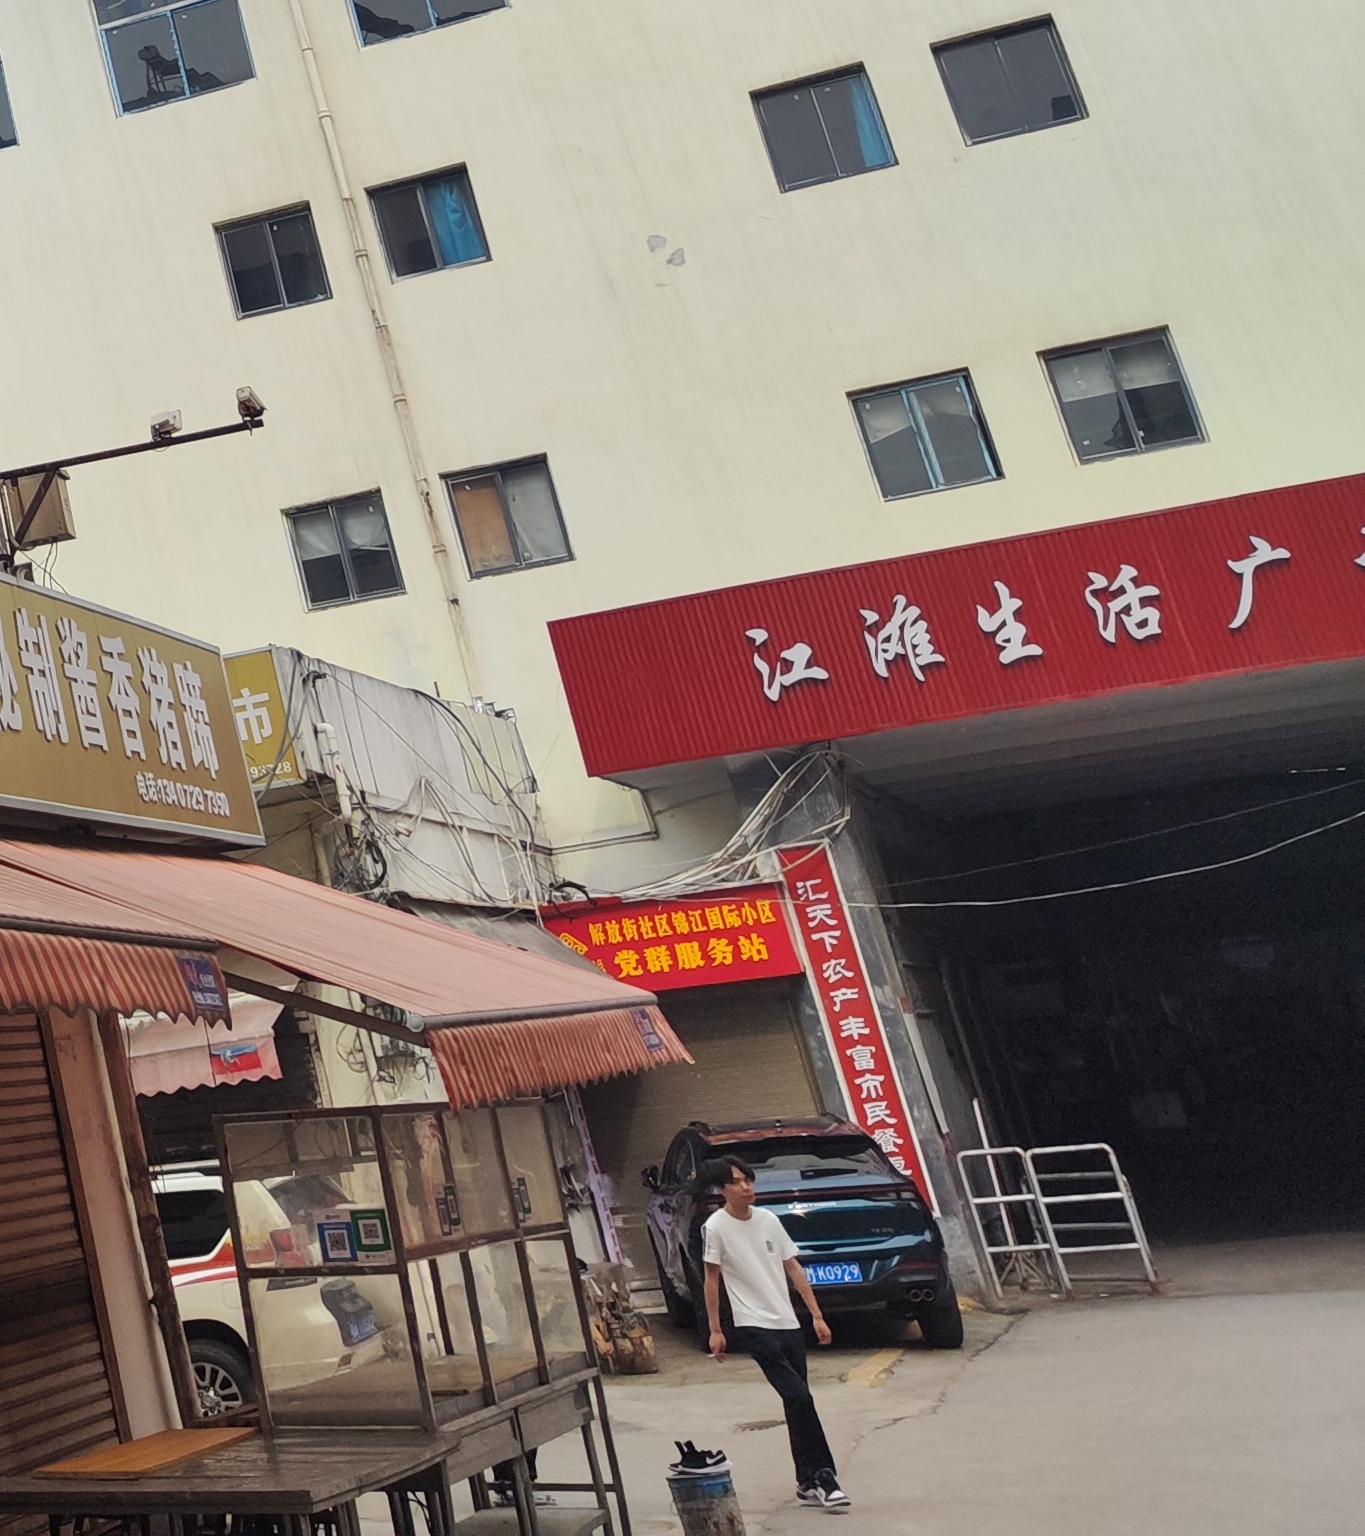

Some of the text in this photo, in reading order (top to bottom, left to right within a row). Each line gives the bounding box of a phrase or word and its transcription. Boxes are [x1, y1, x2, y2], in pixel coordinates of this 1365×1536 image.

[744, 526, 1365, 702] 江滩生活广
[613, 932, 769, 978] 党群服务站
